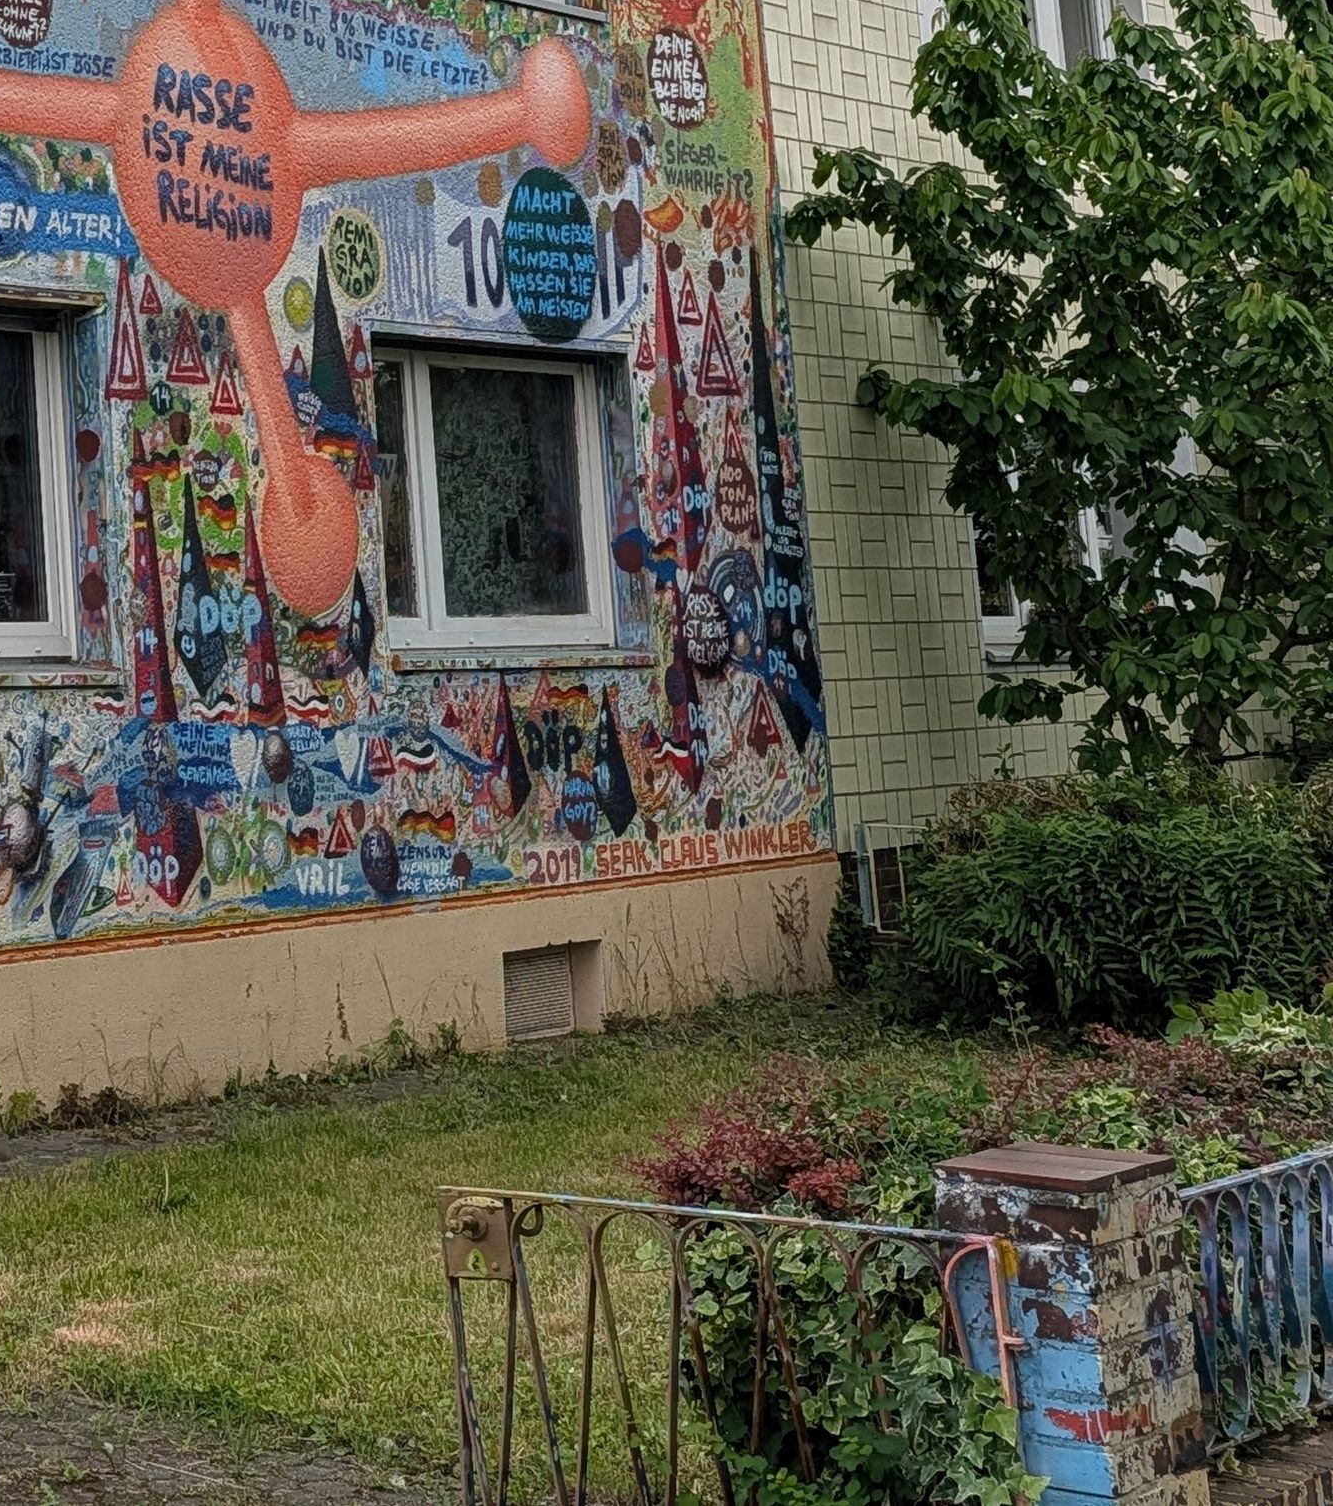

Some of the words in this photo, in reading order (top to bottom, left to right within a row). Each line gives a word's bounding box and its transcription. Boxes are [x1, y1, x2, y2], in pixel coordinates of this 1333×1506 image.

[257, 18, 296, 40] UND
[304, 29, 326, 52] DU
[336, 39, 375, 64] BIST
[383, 50, 414, 74] DIE
[651, 59, 703, 80] ENKEL
[153, 62, 255, 133] RASSE
[142, 114, 194, 166] IST
[200, 141, 274, 192] MEINE
[157, 169, 273, 242] RELIGION
[514, 185, 576, 215] MACHT
[45, 210, 122, 247] ALTER!
[334, 216, 374, 249] REMI
[505, 222, 545, 243] MEHR
[335, 244, 373, 267] GRA
[336, 266, 376, 294] TION
[571, 274, 592, 294] SIE
[724, 820, 817, 860] WINKLER
[295, 860, 351, 896] VRIL
